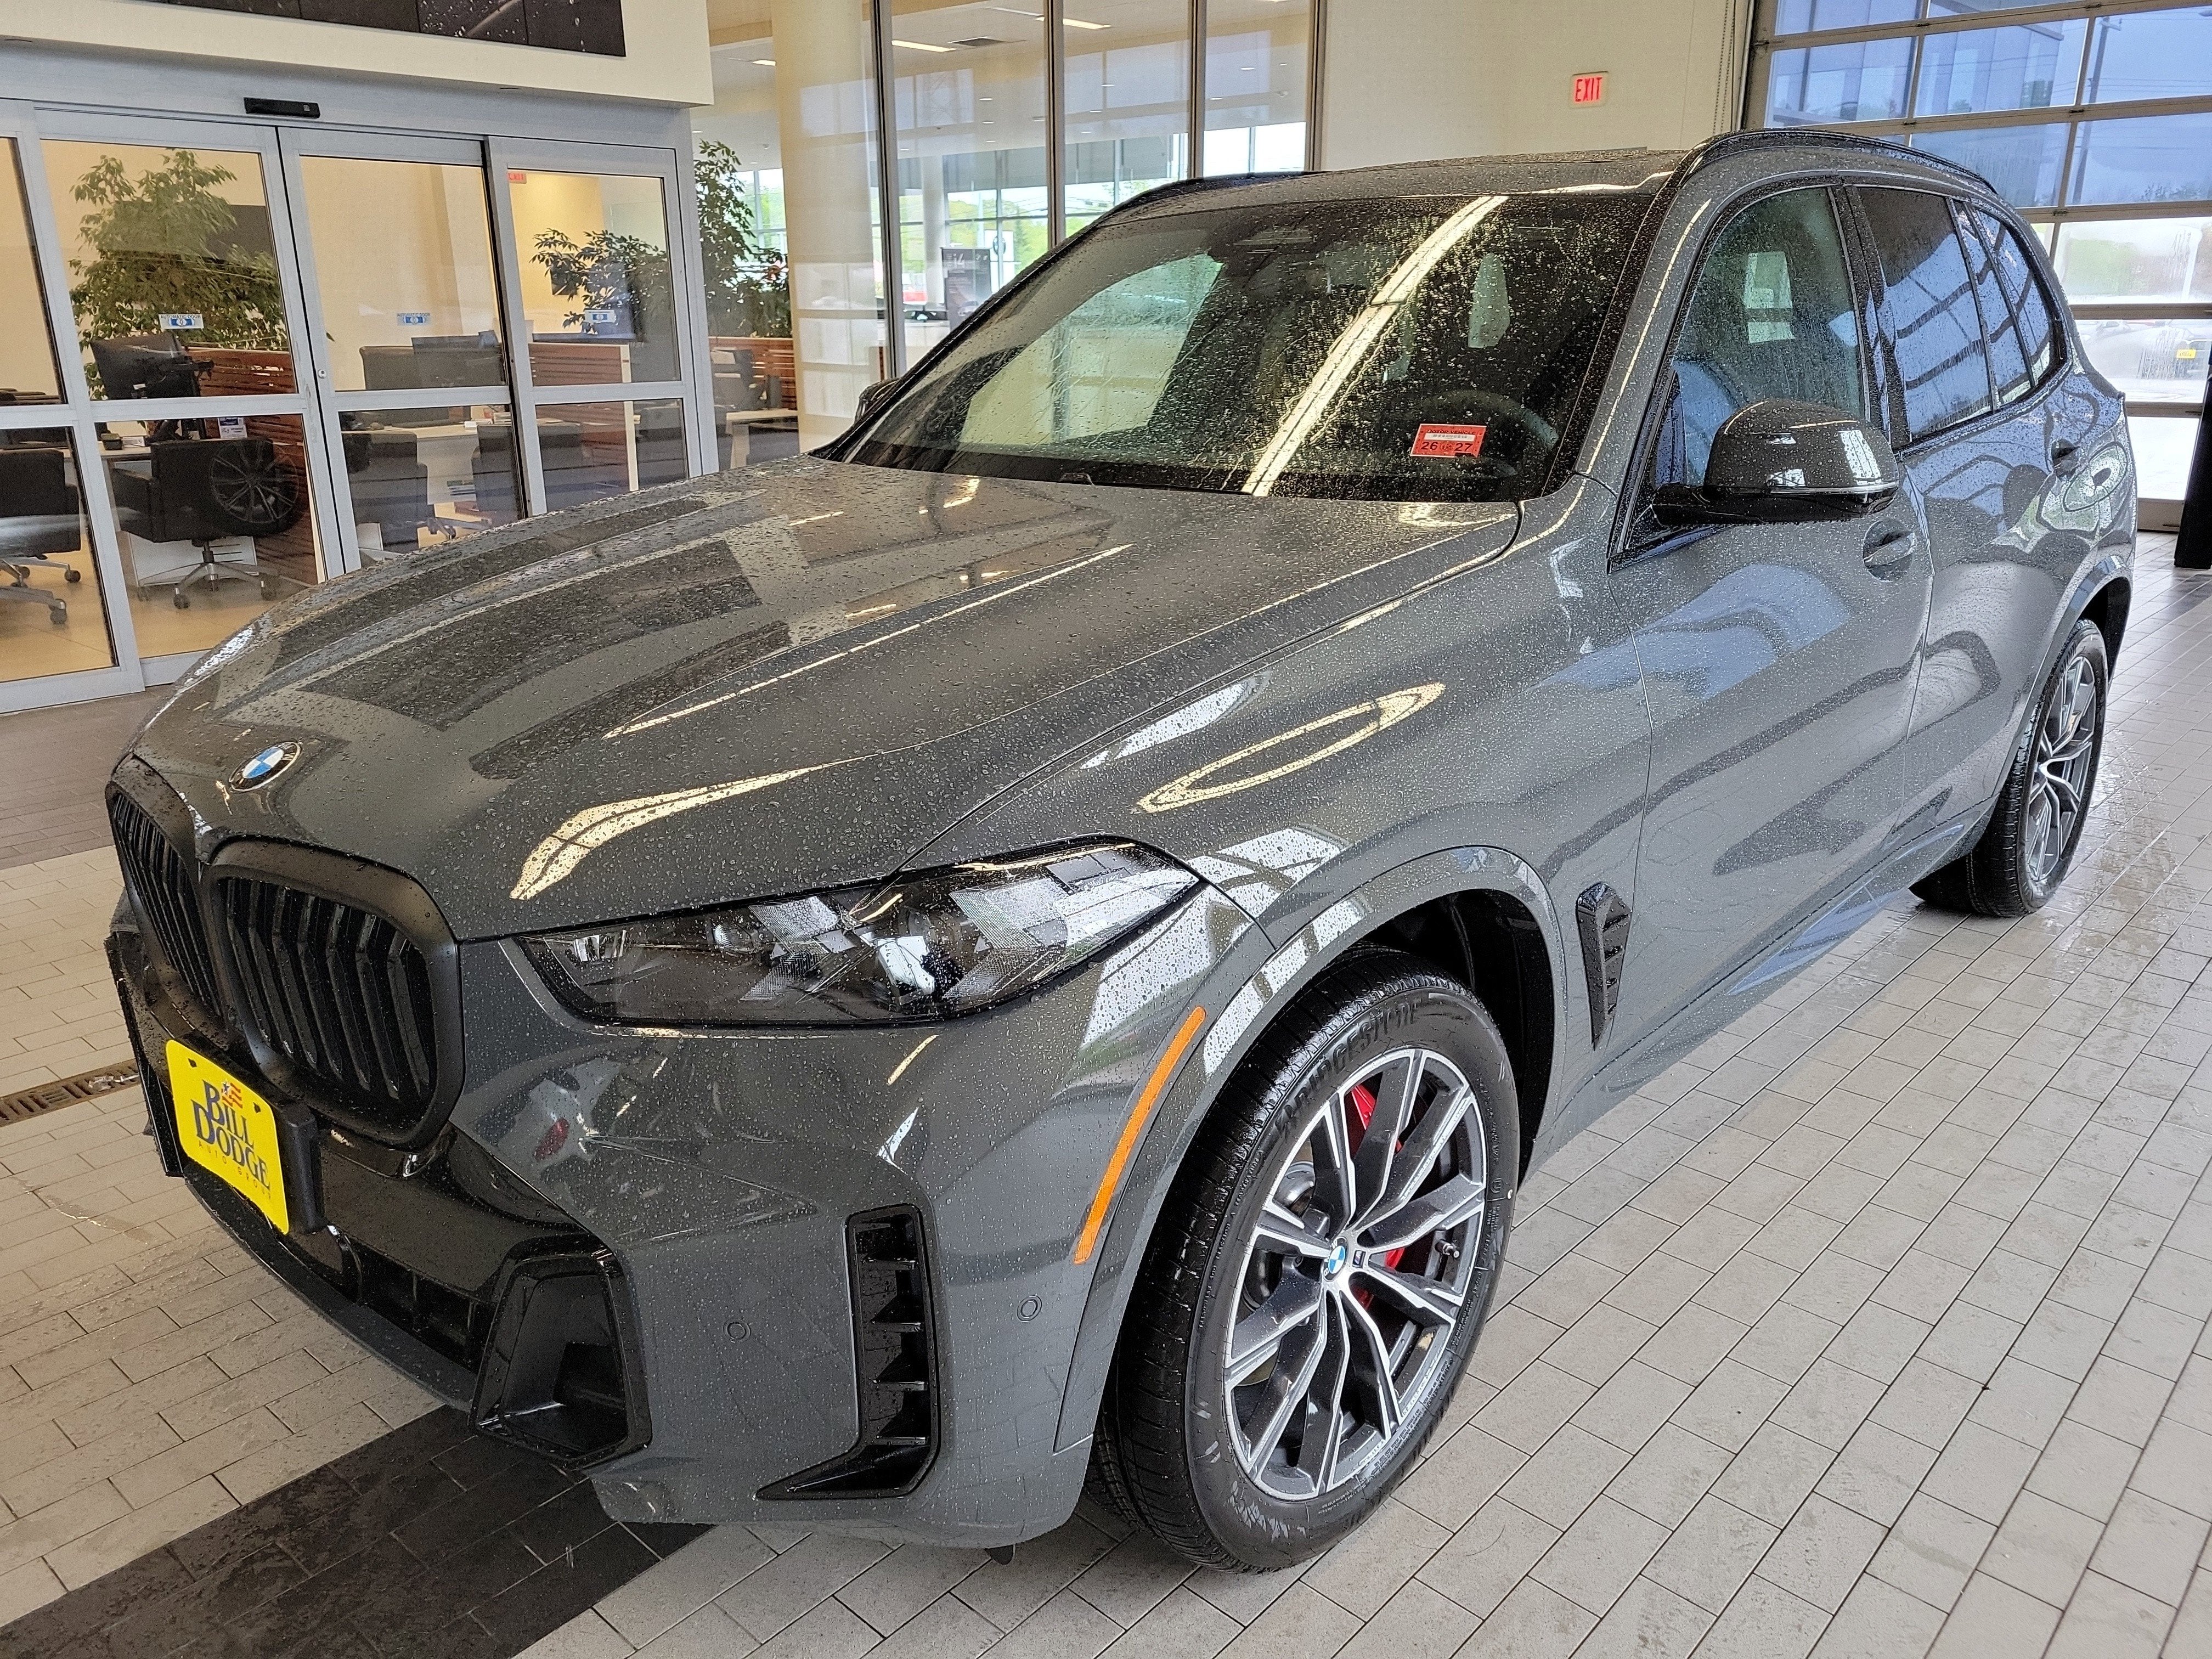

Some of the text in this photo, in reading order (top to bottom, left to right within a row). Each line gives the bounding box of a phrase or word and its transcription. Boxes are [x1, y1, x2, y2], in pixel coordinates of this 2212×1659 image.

[1575, 77, 1602, 102] EXIT
[1420, 441, 1438, 450] 26
[1454, 443, 1474, 452] 27
[203, 1079, 255, 1147] BILL
[191, 1099, 270, 1191] DODGE
[199, 1139, 227, 1164] AUTO
